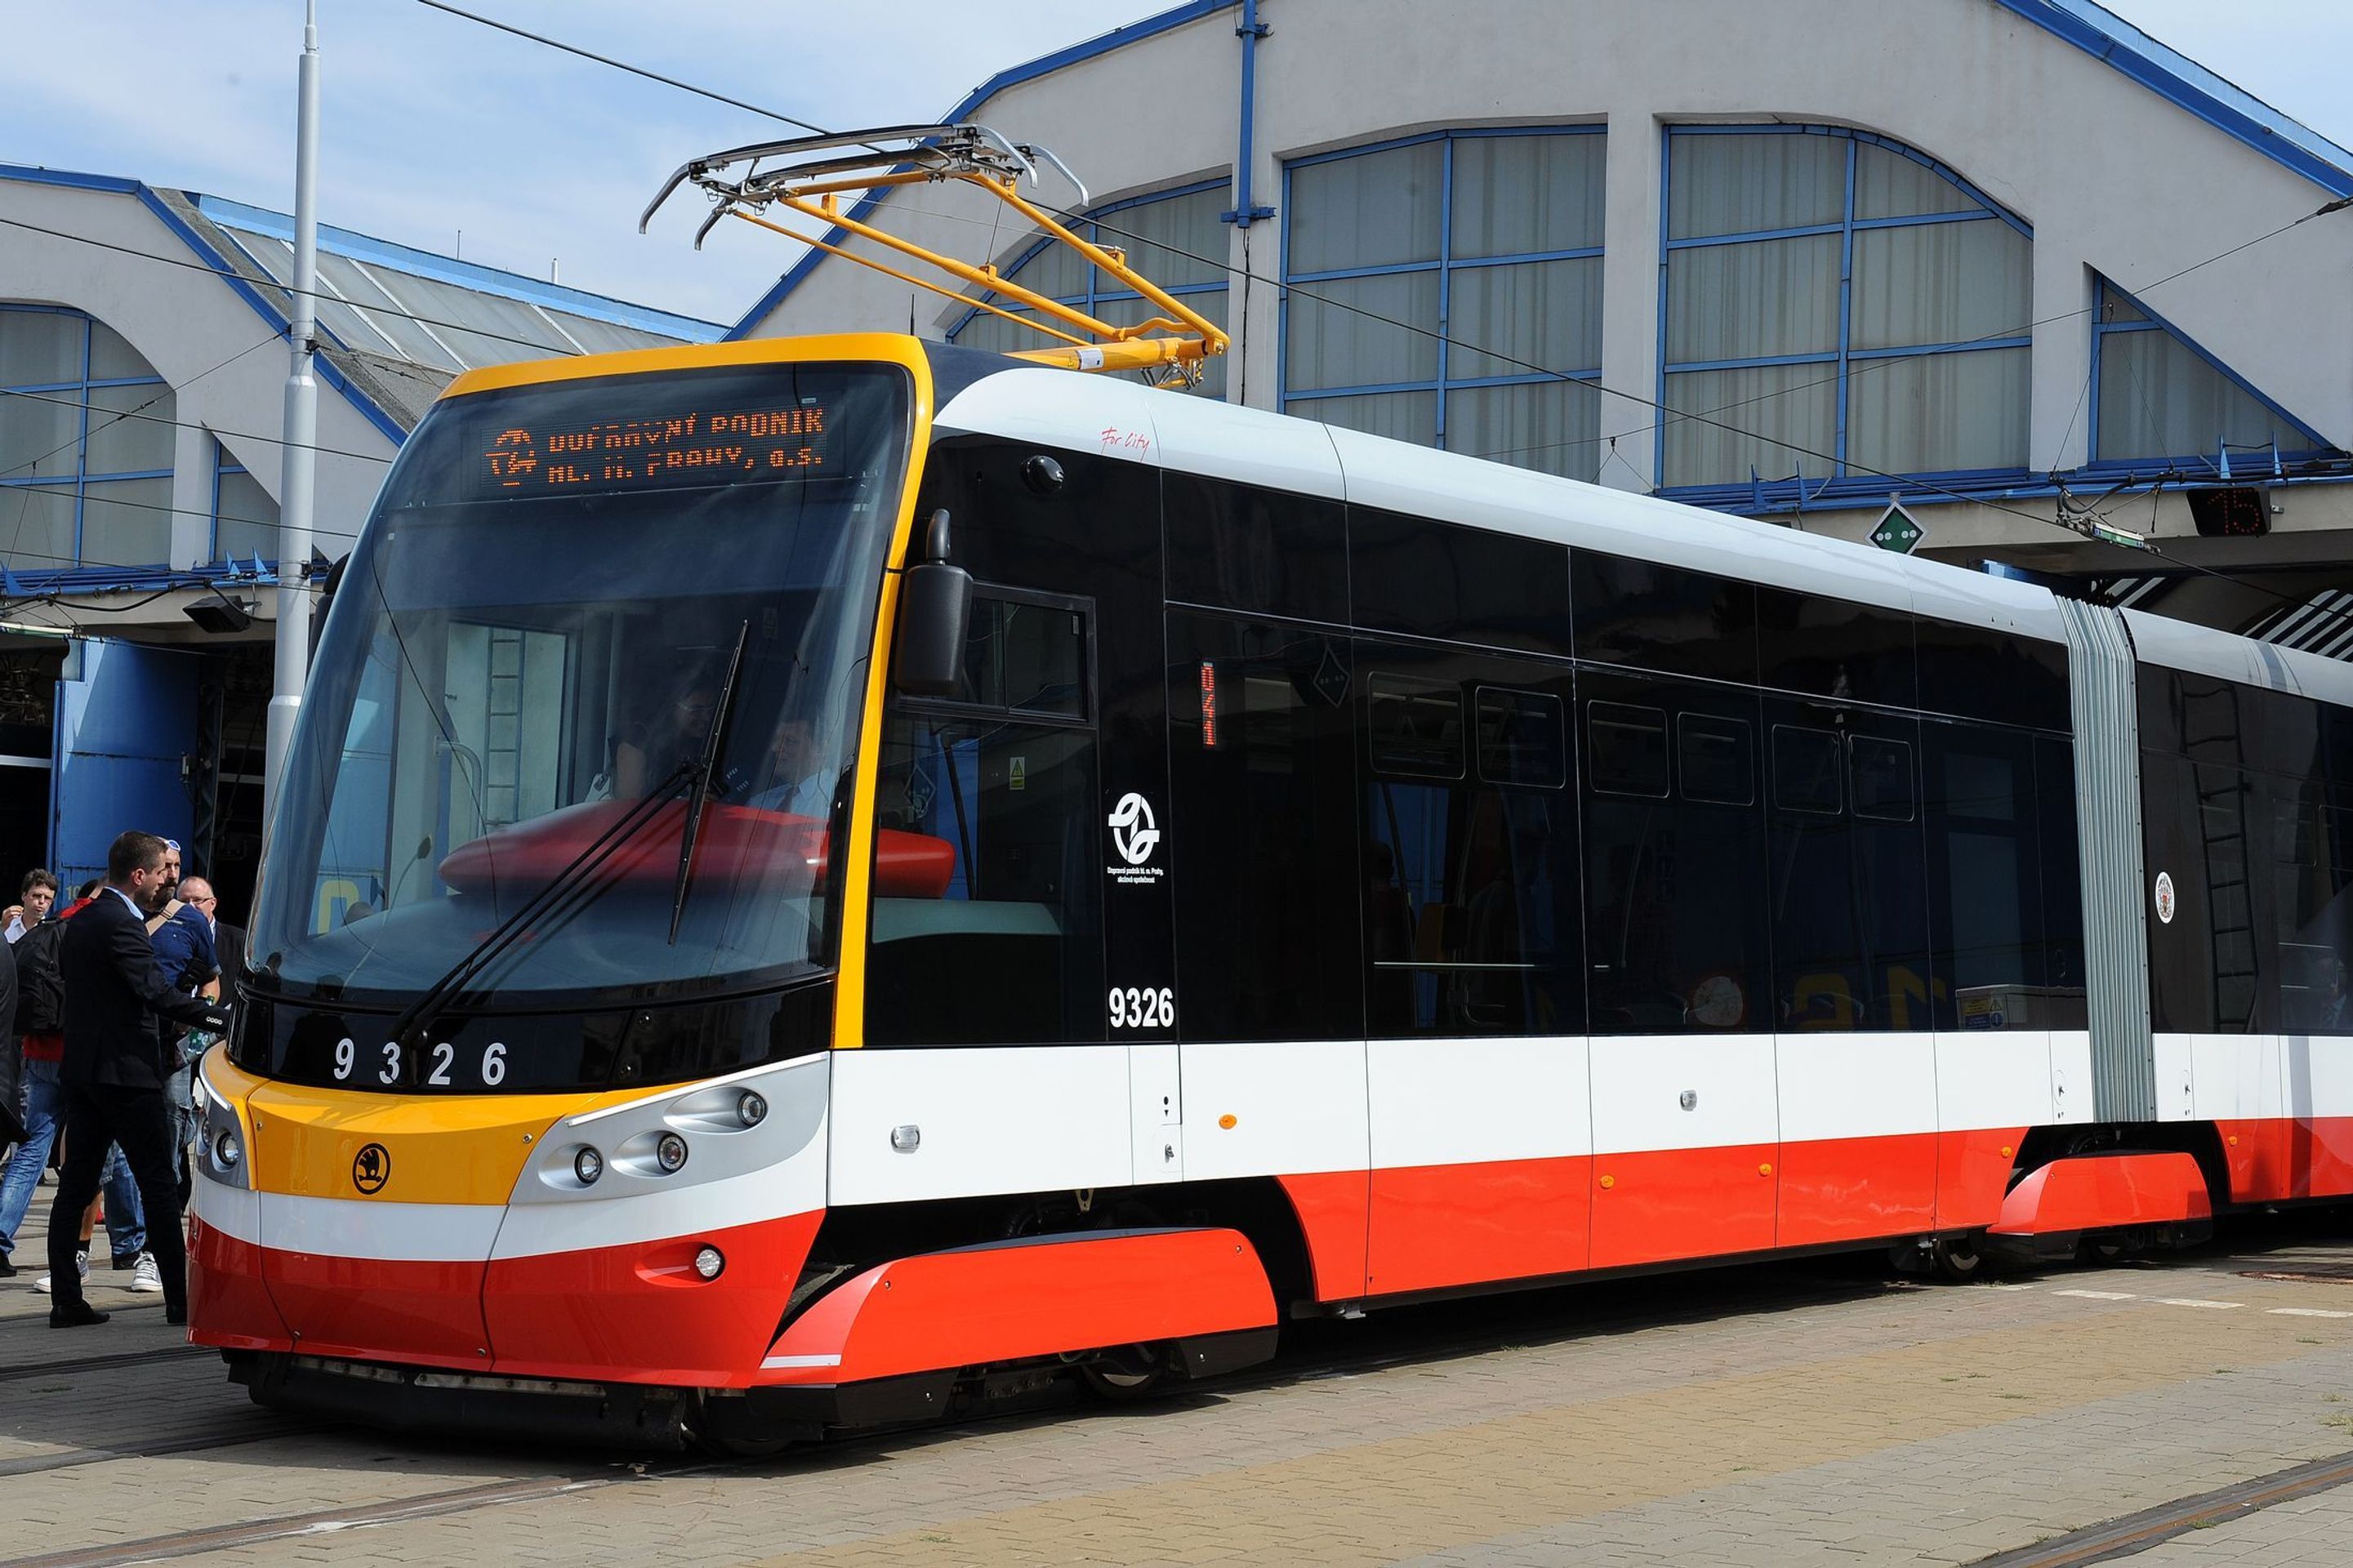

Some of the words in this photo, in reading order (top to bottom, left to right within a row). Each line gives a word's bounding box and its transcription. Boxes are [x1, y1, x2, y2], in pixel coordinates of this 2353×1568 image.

[1124, 432, 1150, 461] City
[1109, 987, 1174, 1027] 9326
[333, 1038, 506, 1086] 9326
